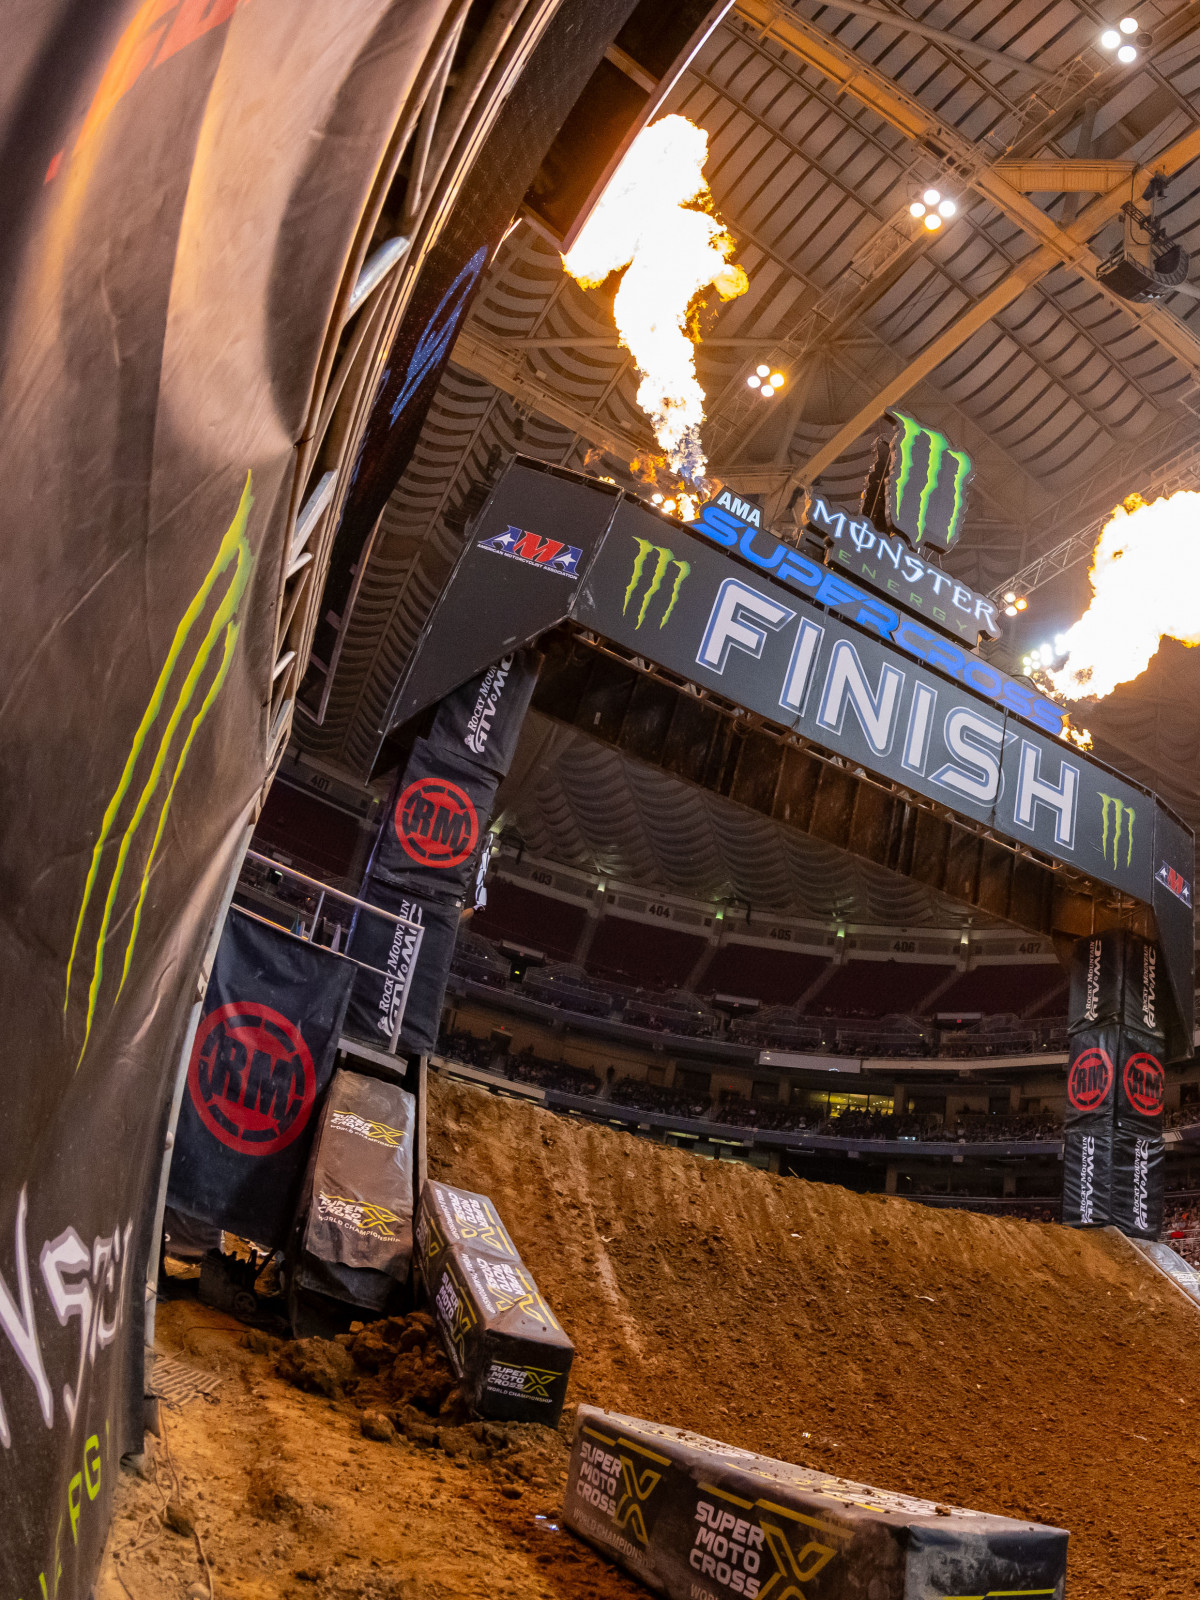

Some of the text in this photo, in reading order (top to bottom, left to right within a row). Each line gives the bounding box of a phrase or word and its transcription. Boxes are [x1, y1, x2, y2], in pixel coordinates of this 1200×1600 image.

[717, 491, 761, 527] AMA
[477, 543, 578, 580] AMERICAN MOTORCYCLIST ASSOCIATION
[478, 525, 583, 577] AMA
[839, 549, 967, 633] ENERGY
[692, 506, 1066, 736] SUPERCROSS
[467, 696, 485, 733] ROCKY
[696, 577, 1079, 850] FINISH
[531, 870, 553, 886] 403
[649, 904, 671, 918] 404
[770, 928, 792, 941] 405
[893, 941, 916, 953] 406
[1018, 942, 1042, 954] 407
[1087, 941, 1095, 983] MOUNTAIN
[1132, 1138, 1142, 1215] ROCKY MOUNTAIN
[487, 1377, 525, 1390] CROSS
[490, 1364, 528, 1378] SUPER
[491, 1371, 525, 1384] MOTO
[486, 1386, 553, 1403] WORLD CHAMPIONSHIP
[579, 1441, 622, 1478] SUPER
[579, 1461, 617, 1496] MOTO
[576, 1479, 617, 1517] CROSS
[694, 1501, 765, 1552] SUPER
[694, 1526, 760, 1575] MOTO
[689, 1548, 761, 1600] CROSS
